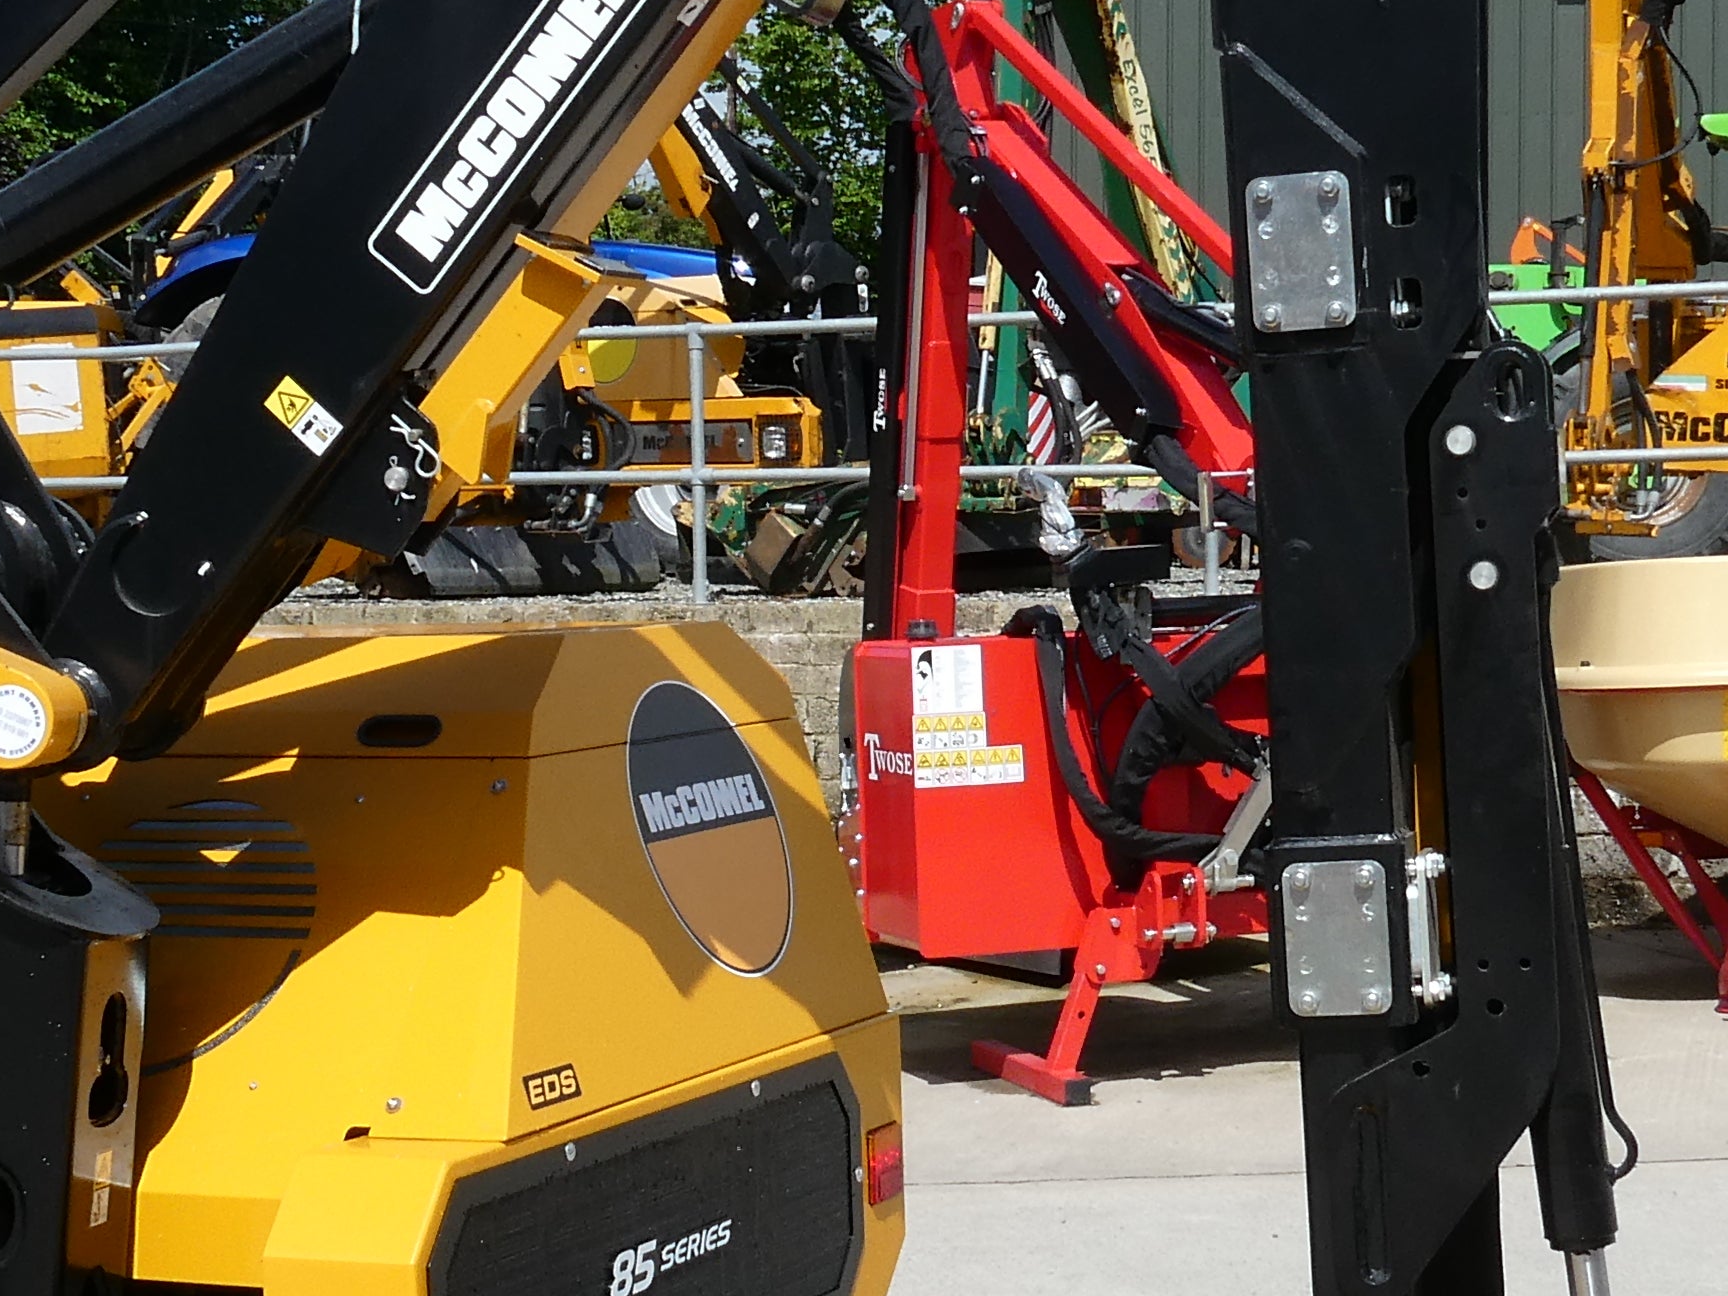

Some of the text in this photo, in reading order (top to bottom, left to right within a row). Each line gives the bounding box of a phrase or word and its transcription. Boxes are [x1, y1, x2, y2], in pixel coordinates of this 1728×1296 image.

[1122, 58, 1148, 116] Excel
[638, 772, 766, 834] McCONNEL
[527, 1068, 577, 1105] EDS
[659, 1218, 733, 1272] SERIES
